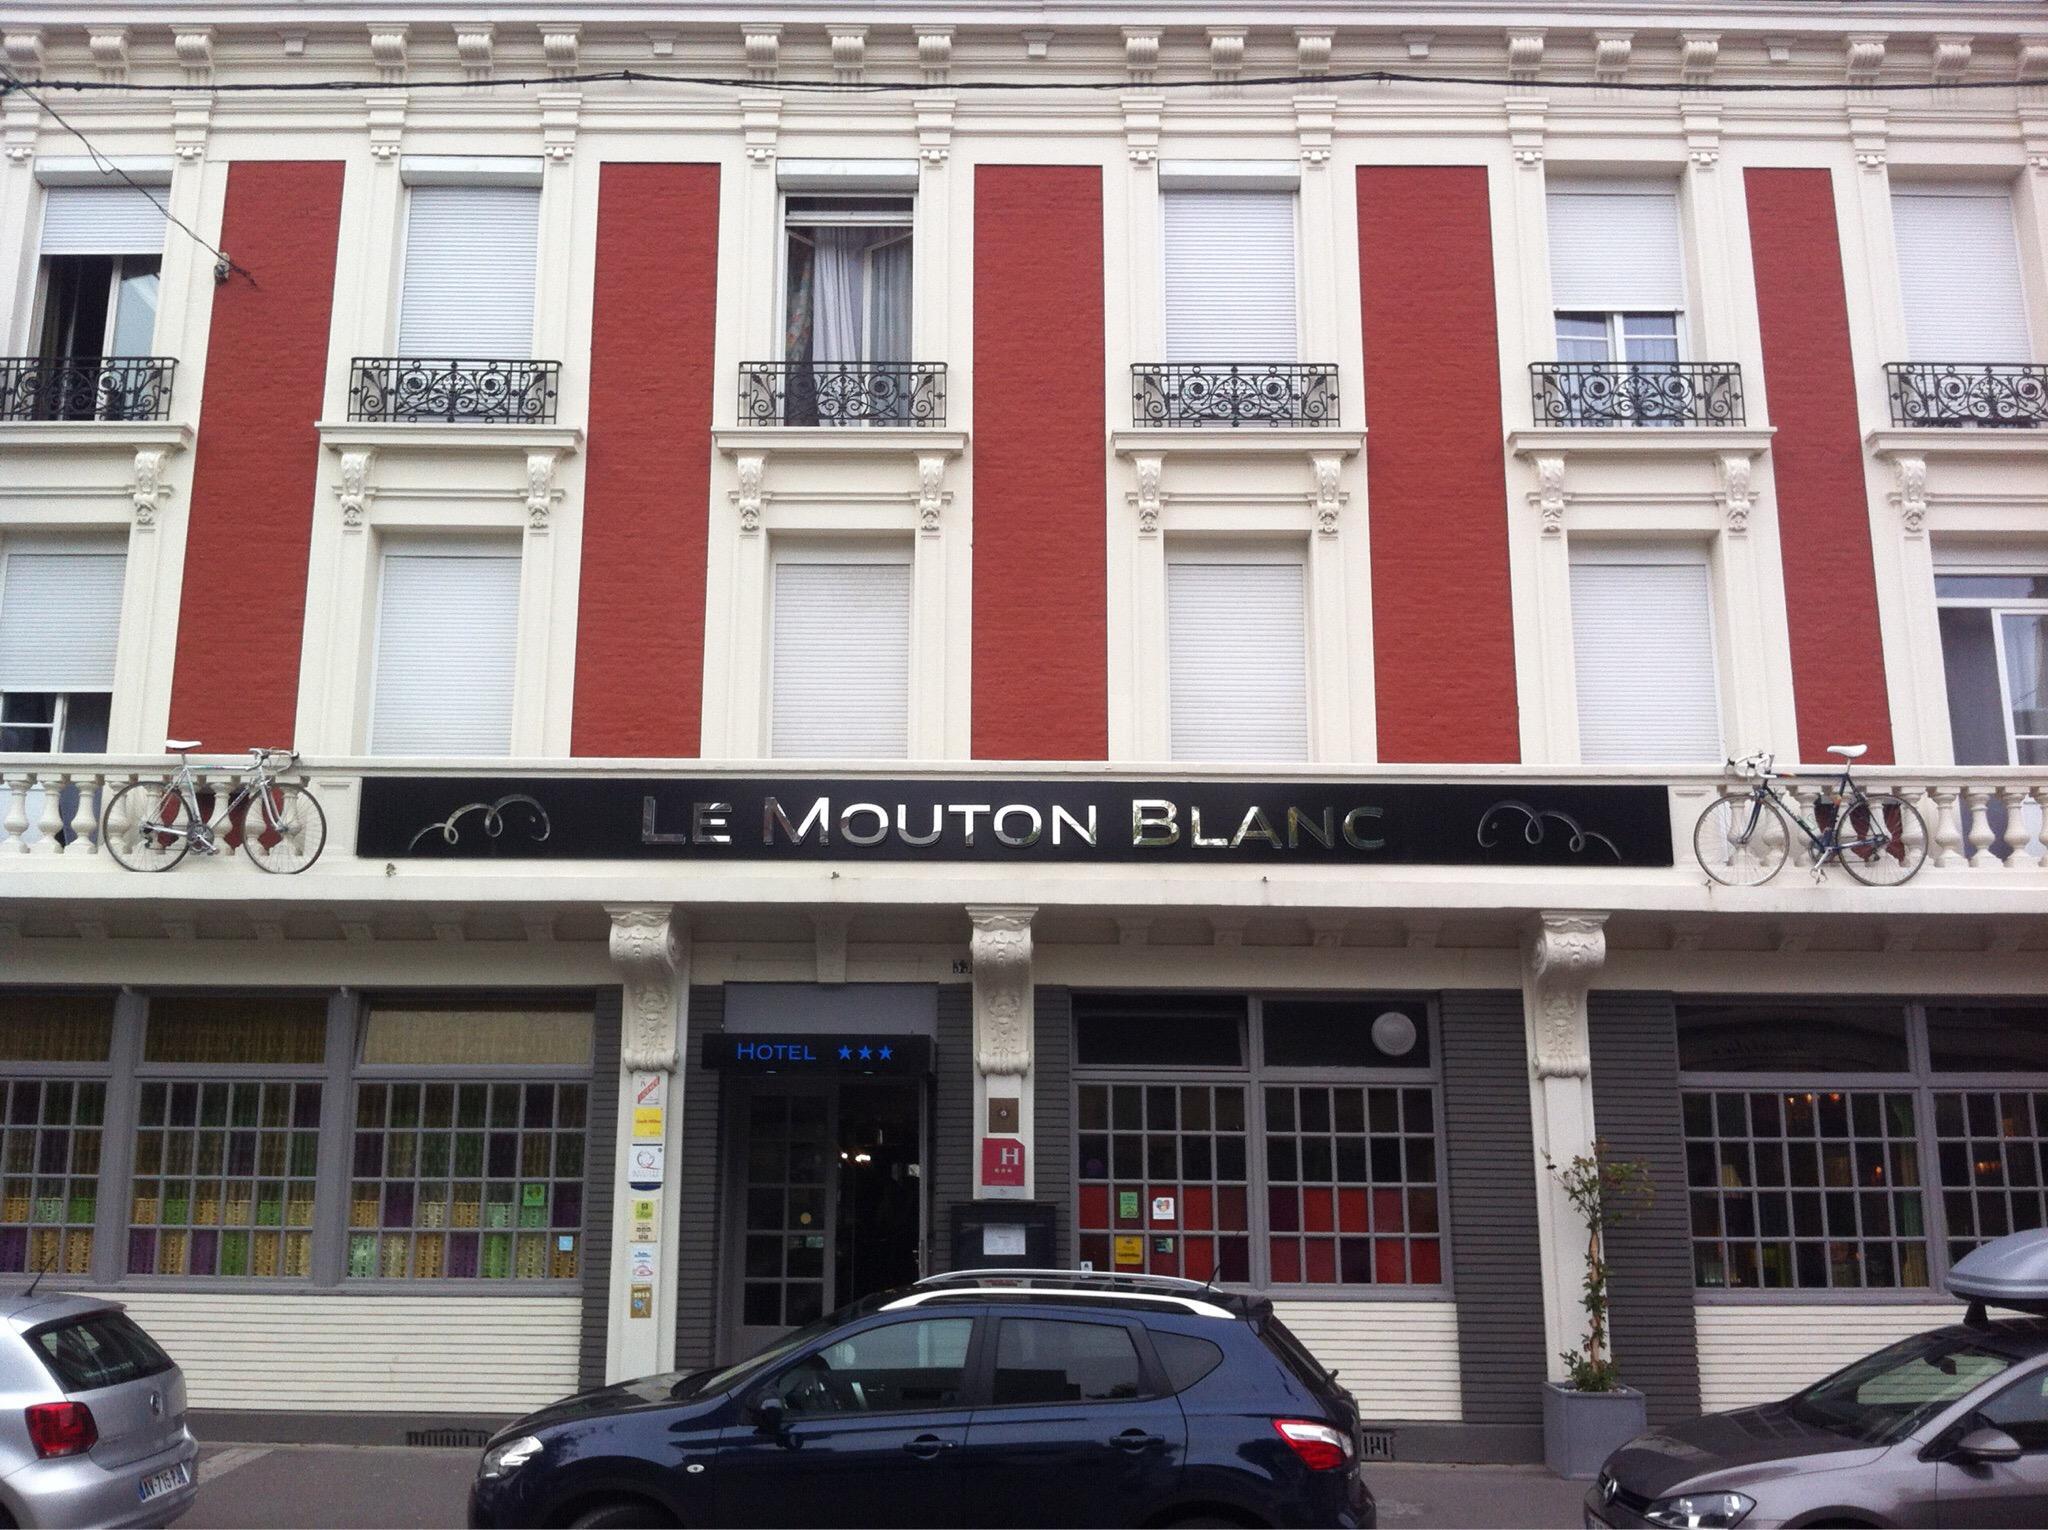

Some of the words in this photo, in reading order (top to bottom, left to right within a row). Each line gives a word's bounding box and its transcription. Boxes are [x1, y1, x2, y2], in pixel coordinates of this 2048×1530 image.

[641, 796, 733, 846] LE
[762, 796, 1098, 849] MOUTON
[1132, 799, 1386, 850] BLANC
[736, 1043, 817, 1061] HOTEL
[1001, 1147, 1019, 1165] H
